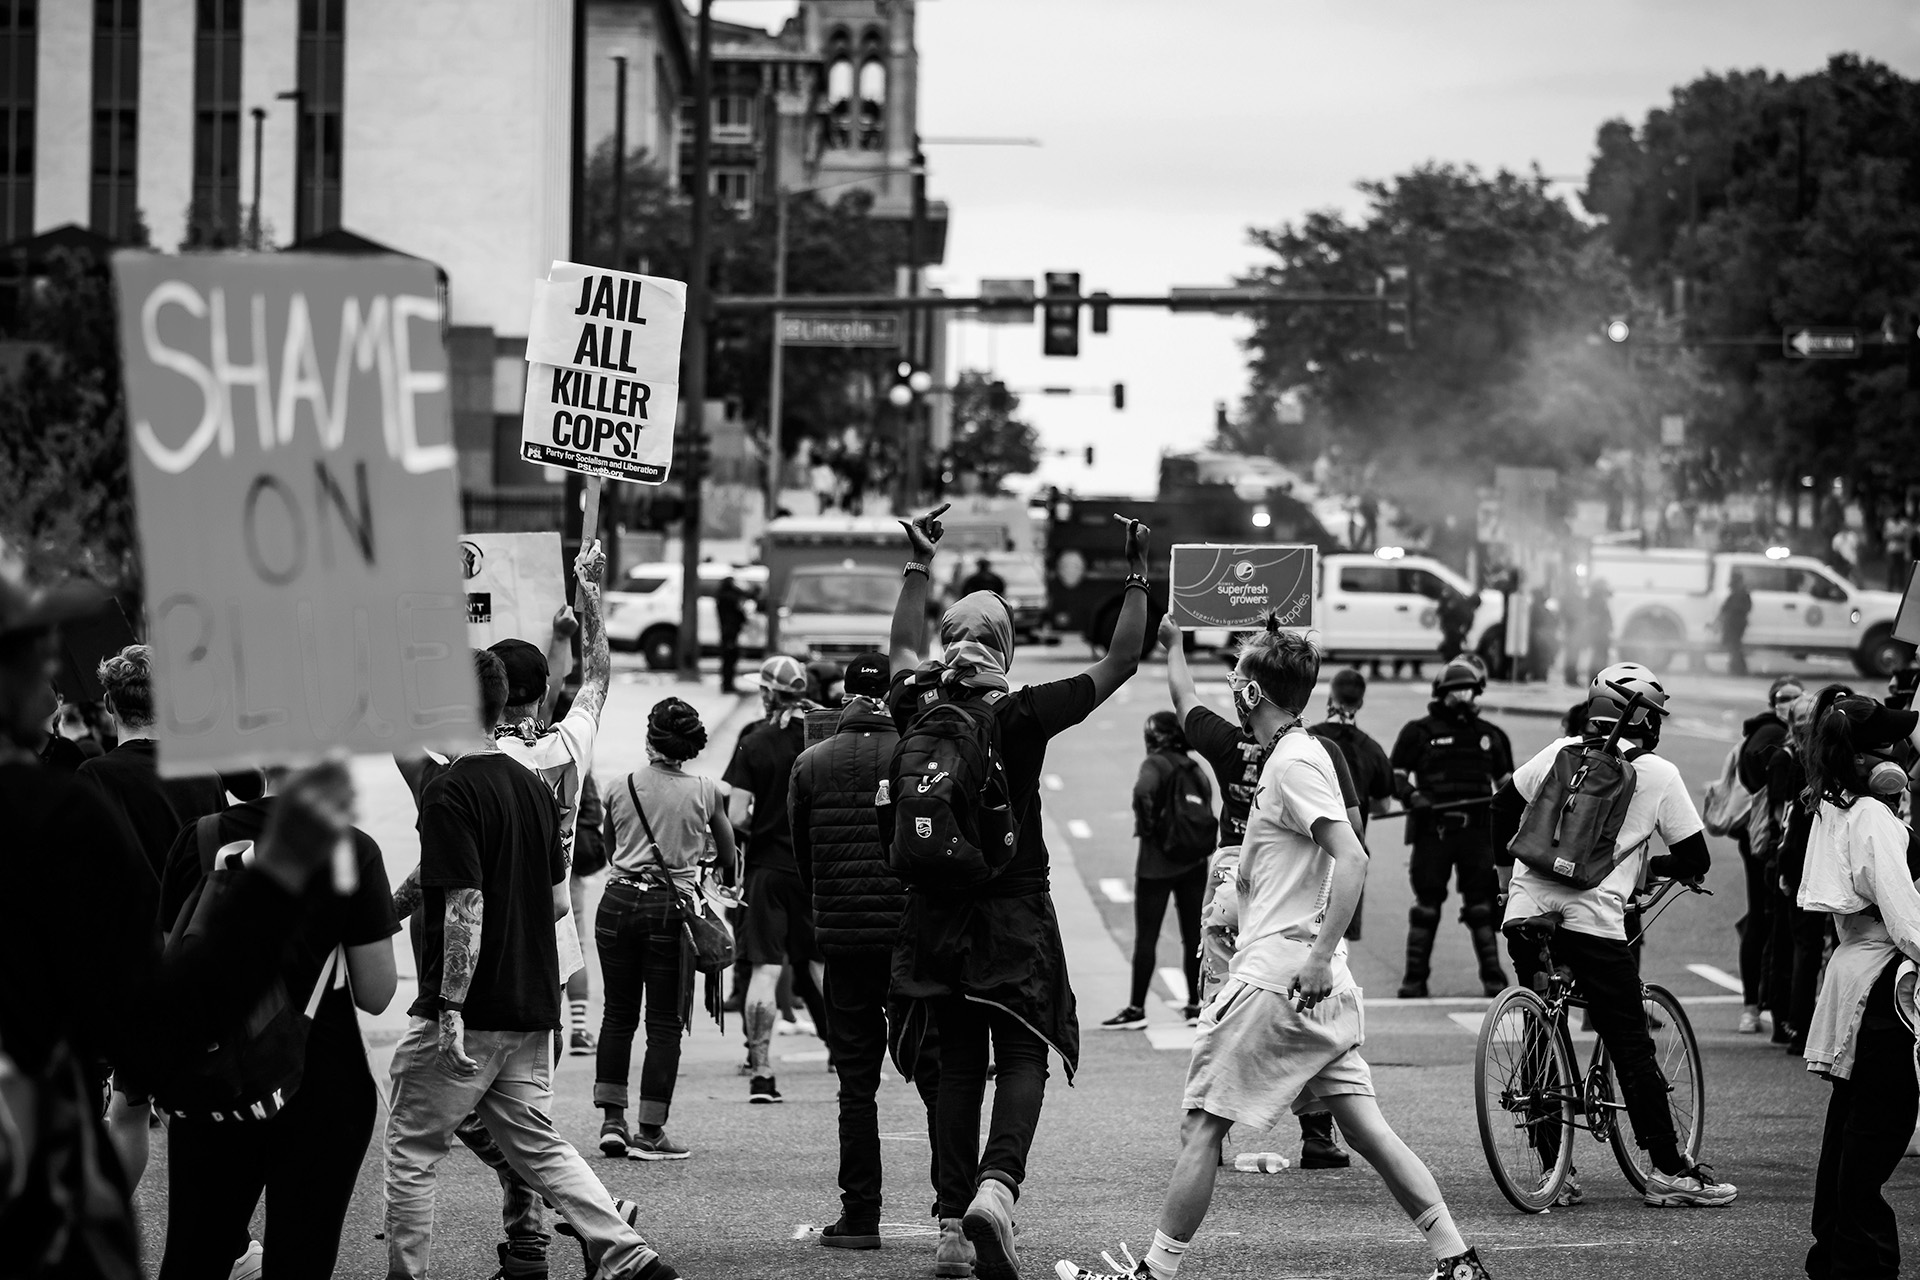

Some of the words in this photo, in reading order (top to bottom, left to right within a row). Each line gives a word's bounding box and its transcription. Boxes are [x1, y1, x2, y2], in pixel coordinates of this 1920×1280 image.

[575, 275, 647, 325] JAIL
[573, 322, 637, 374] ALL
[800, 319, 872, 341] Lincoln
[134, 279, 458, 474] SHAME
[551, 368, 651, 420] KILLER
[552, 410, 644, 460] COPS!
[546, 447, 564, 459] Party
[565, 451, 575, 460] for
[575, 453, 609, 467] Socialism
[609, 461, 622, 469] and
[623, 461, 658, 475] Liberation
[577, 462, 624, 478] PSLweb.org
[242, 457, 377, 587] ON
[1217, 583, 1268, 597] superfresh
[1230, 595, 1268, 607] growers
[1280, 592, 1311, 625] apples
[156, 591, 475, 743] BLUE
[861, 666, 879, 674] Love
